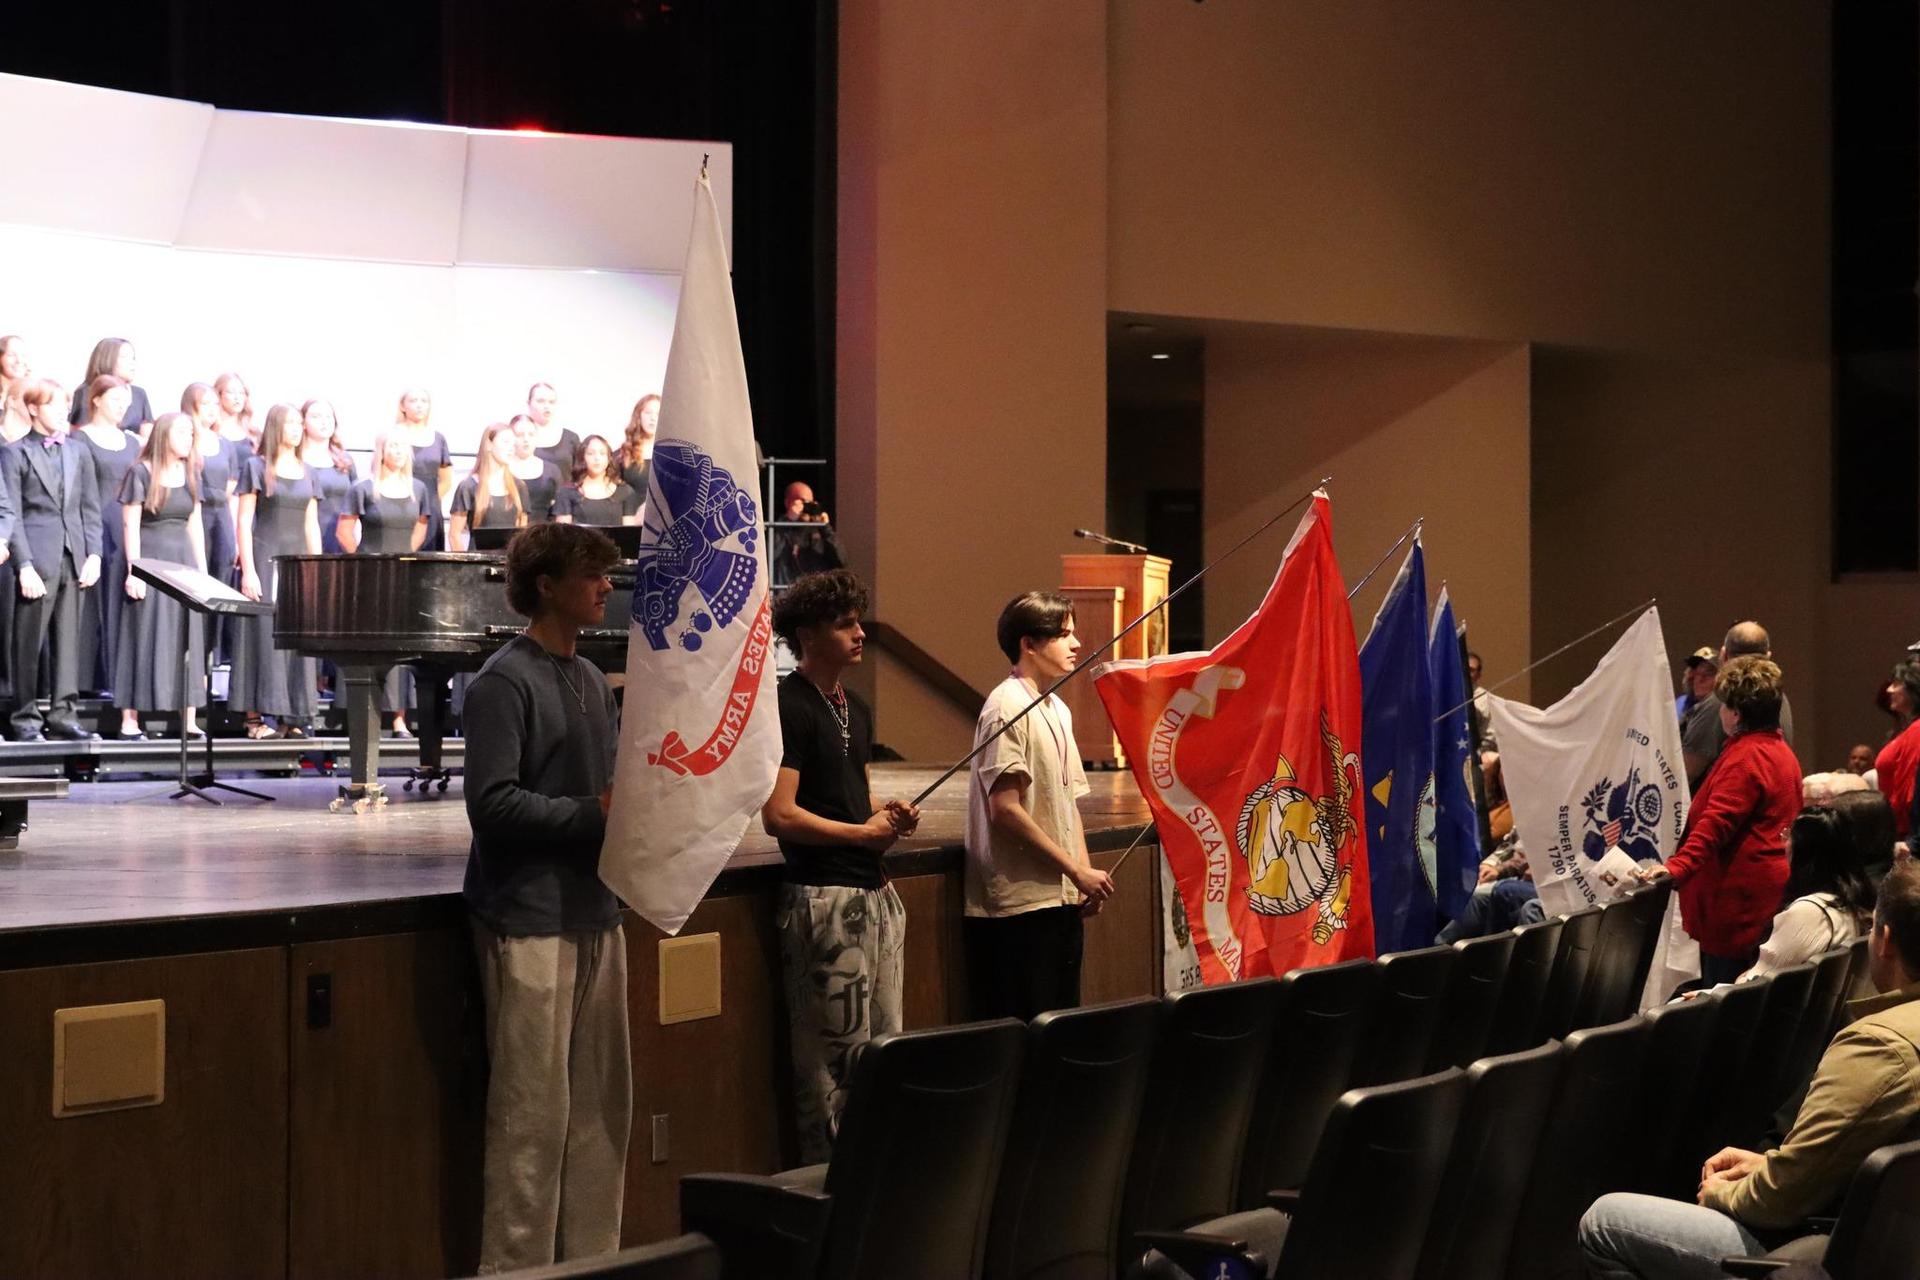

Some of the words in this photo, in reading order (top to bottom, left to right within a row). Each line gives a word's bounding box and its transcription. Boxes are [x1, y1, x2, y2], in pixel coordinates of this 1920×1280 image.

[1655, 749, 1678, 790] STATES
[1153, 707, 1186, 790] UNITED
[1186, 806, 1224, 903] STATES
[1217, 937, 1241, 981] MA
[1548, 845, 1566, 876] 1790
[1559, 805, 1572, 853] SEMPER
[1566, 854, 1596, 904] PARATUS
